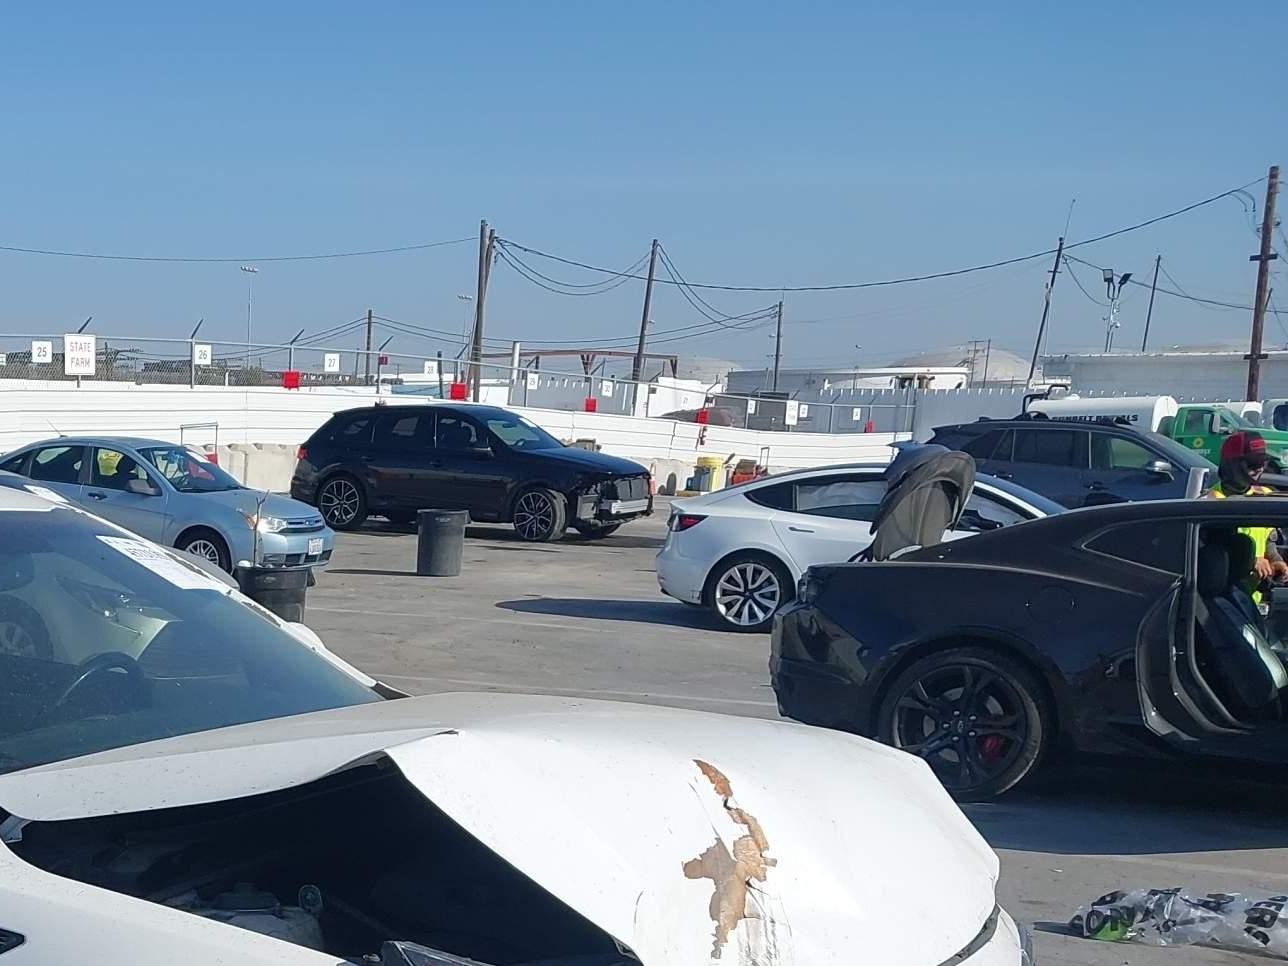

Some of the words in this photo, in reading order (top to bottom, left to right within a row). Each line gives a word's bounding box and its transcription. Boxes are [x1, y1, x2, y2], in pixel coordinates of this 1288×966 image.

[37, 346, 47, 358] 25
[69, 341, 92, 353] STATE
[198, 350, 208, 360] 26
[70, 357, 91, 368] FARM
[328, 358, 337, 368] 27
